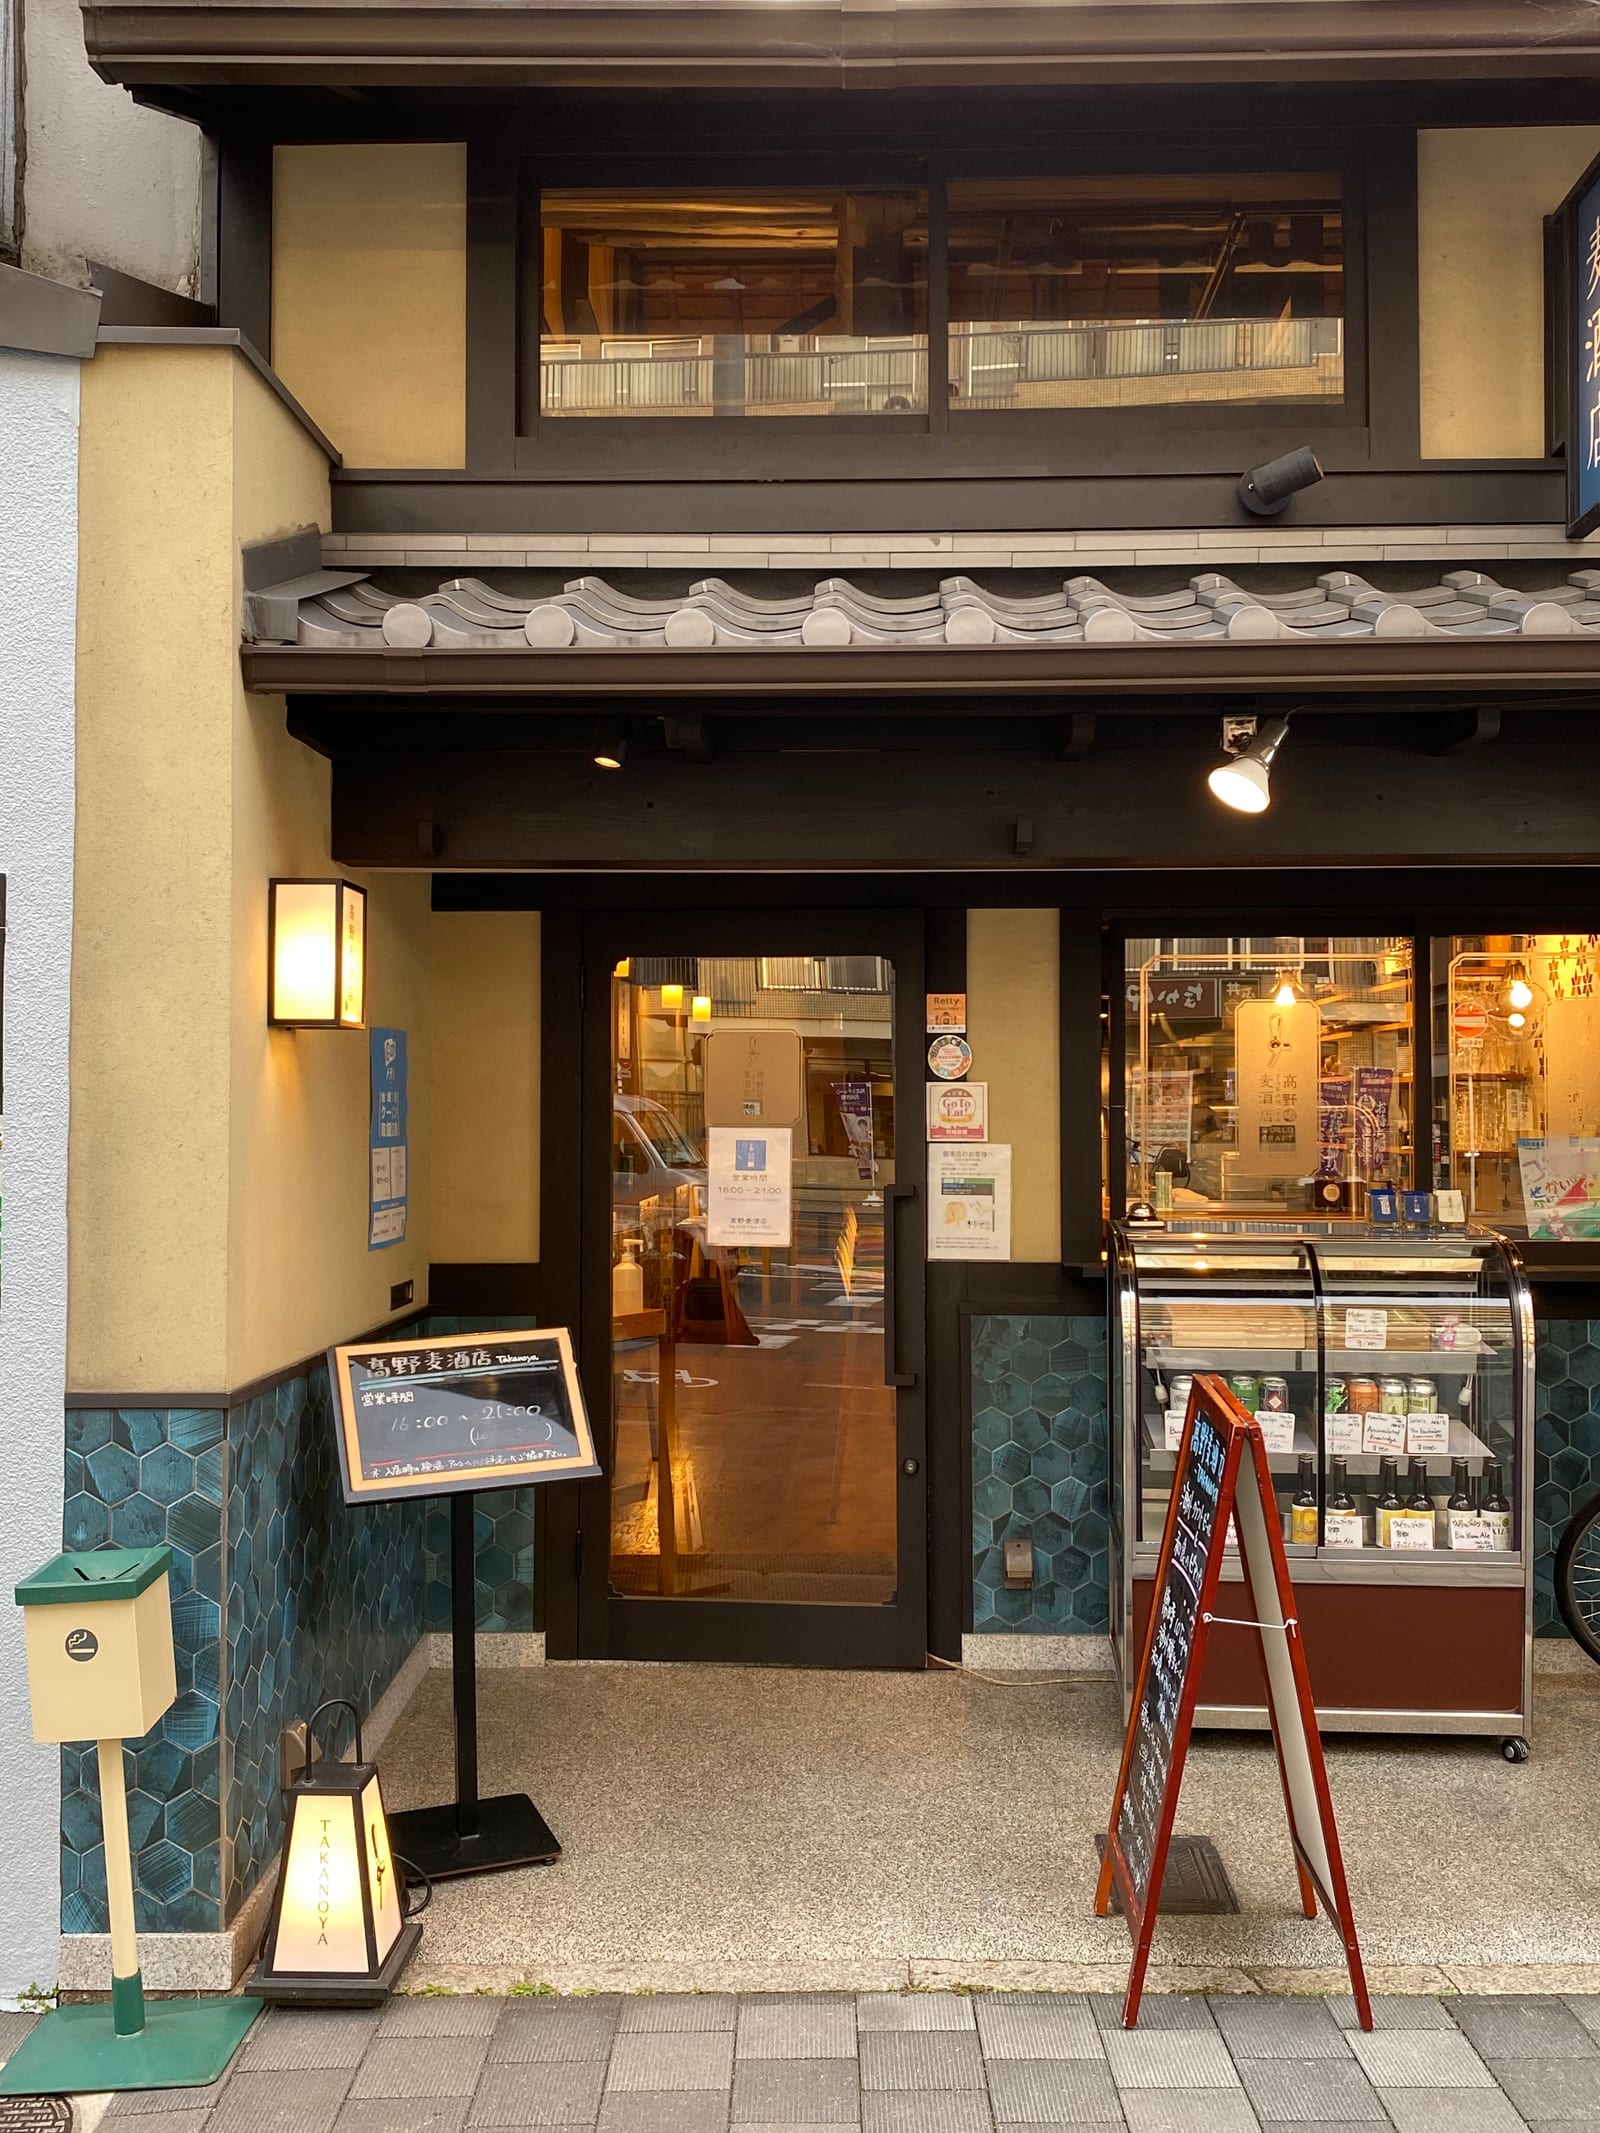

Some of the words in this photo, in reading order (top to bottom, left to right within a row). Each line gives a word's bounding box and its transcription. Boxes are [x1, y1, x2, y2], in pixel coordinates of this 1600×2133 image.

[934, 997, 960, 1006] Retty
[731, 1174, 768, 1182] 営業時間
[754, 1187, 782, 1195] 21:00
[361, 1391, 415, 1407] 営業時間
[481, 1405, 541, 1420] 21:00
[317, 1819, 332, 1946] TAKANOYA
